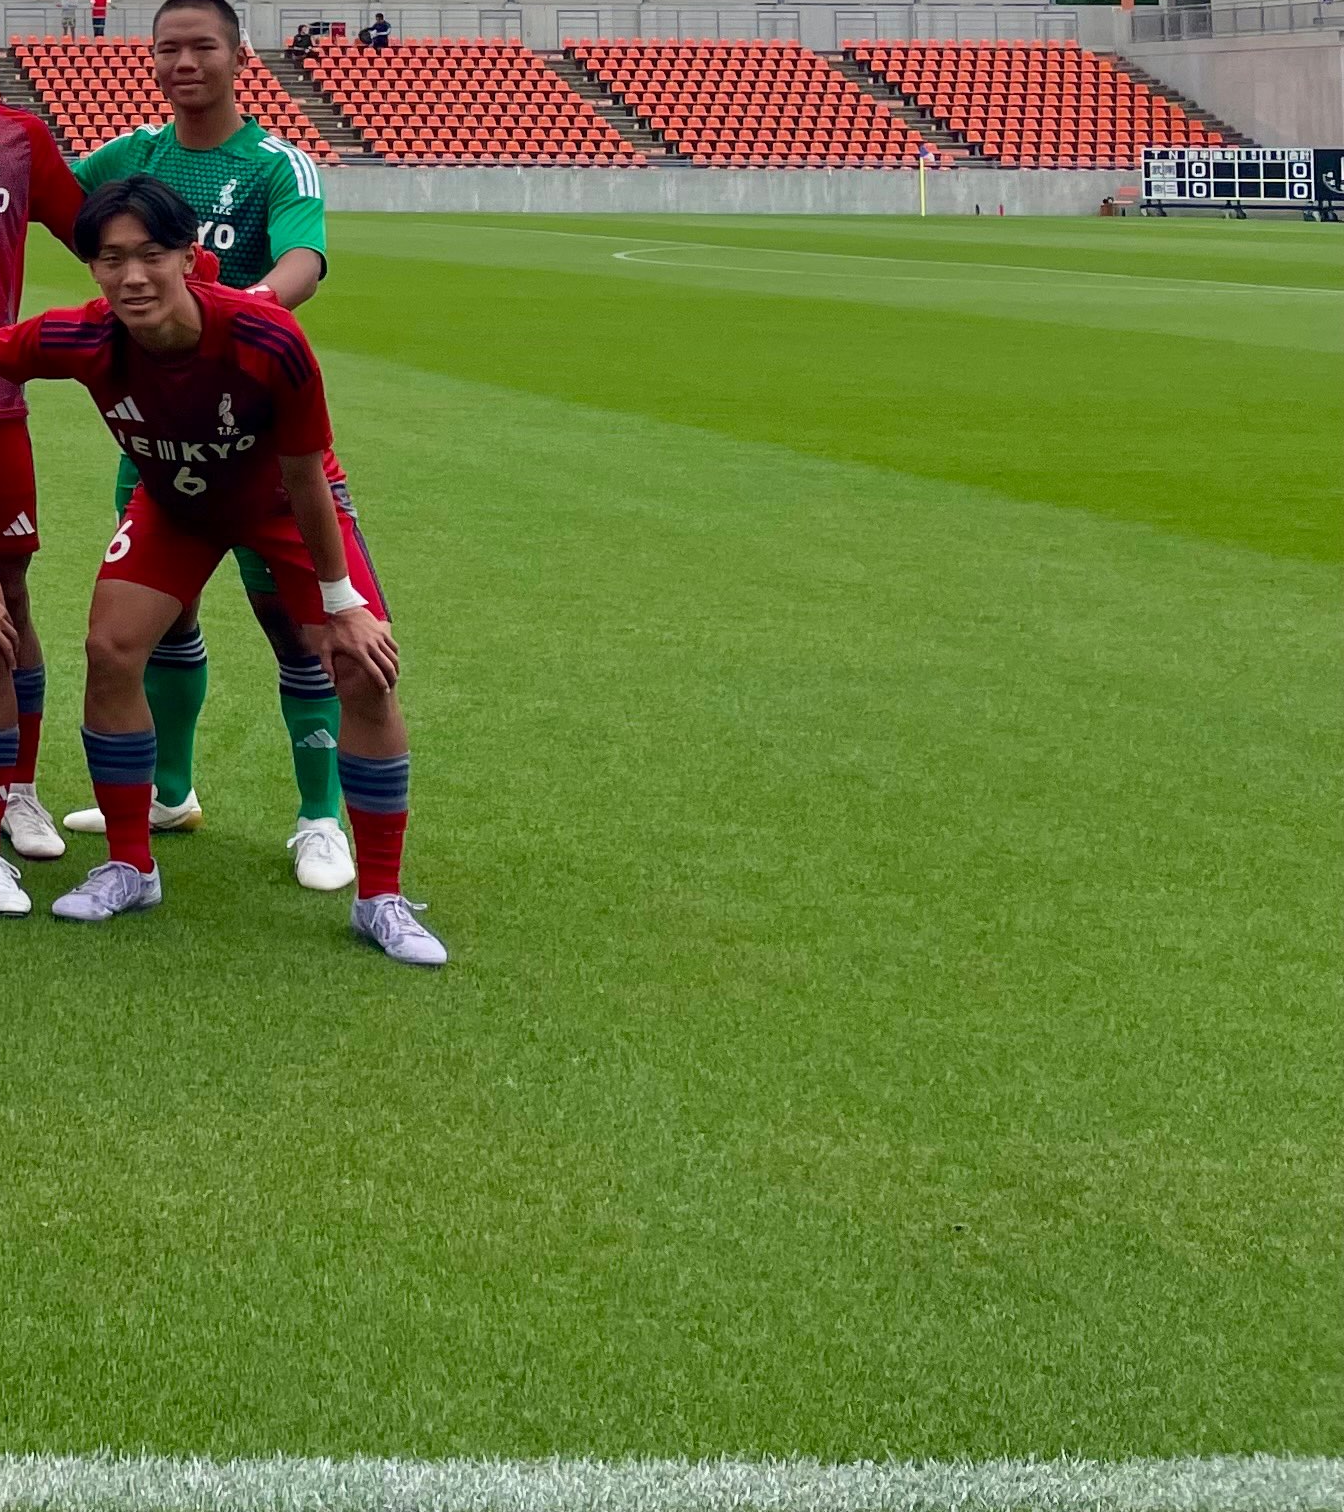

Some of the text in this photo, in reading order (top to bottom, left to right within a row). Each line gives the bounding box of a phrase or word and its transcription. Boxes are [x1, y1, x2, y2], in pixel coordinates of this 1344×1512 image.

[1191, 162, 1207, 178] 0
[1292, 162, 1308, 178] 0
[1192, 182, 1208, 197] 0
[1293, 183, 1309, 198] 0
[174, 467, 206, 495] 6
[105, 518, 132, 562] 6
